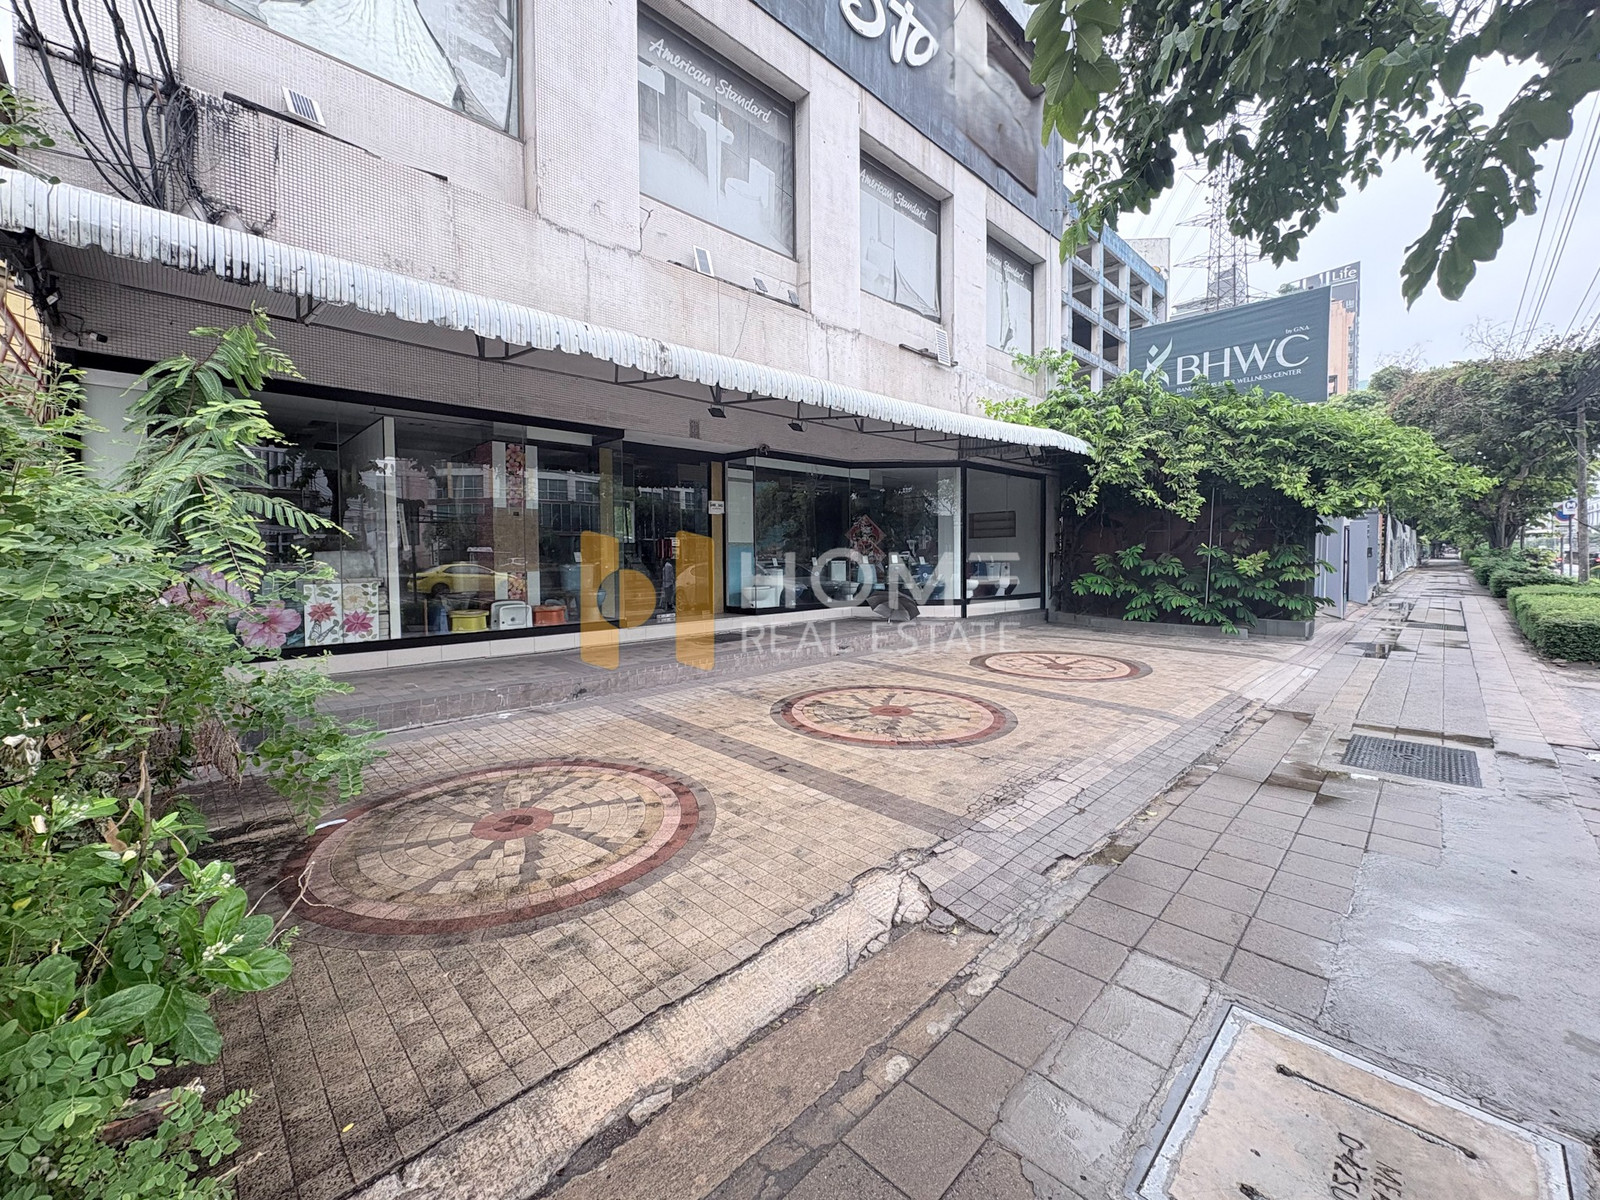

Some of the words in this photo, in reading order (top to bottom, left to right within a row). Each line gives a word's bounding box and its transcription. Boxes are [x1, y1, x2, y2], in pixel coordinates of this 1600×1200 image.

[649, 38, 711, 87] American
[715, 79, 771, 123] Standard
[860, 168, 894, 200] American
[895, 192, 928, 221] Standard
[1332, 266, 1358, 281] Life
[1176, 334, 1310, 385] BHWC
[1236, 373, 1272, 384] WELLNESS
[1273, 368, 1302, 379] CENTER
